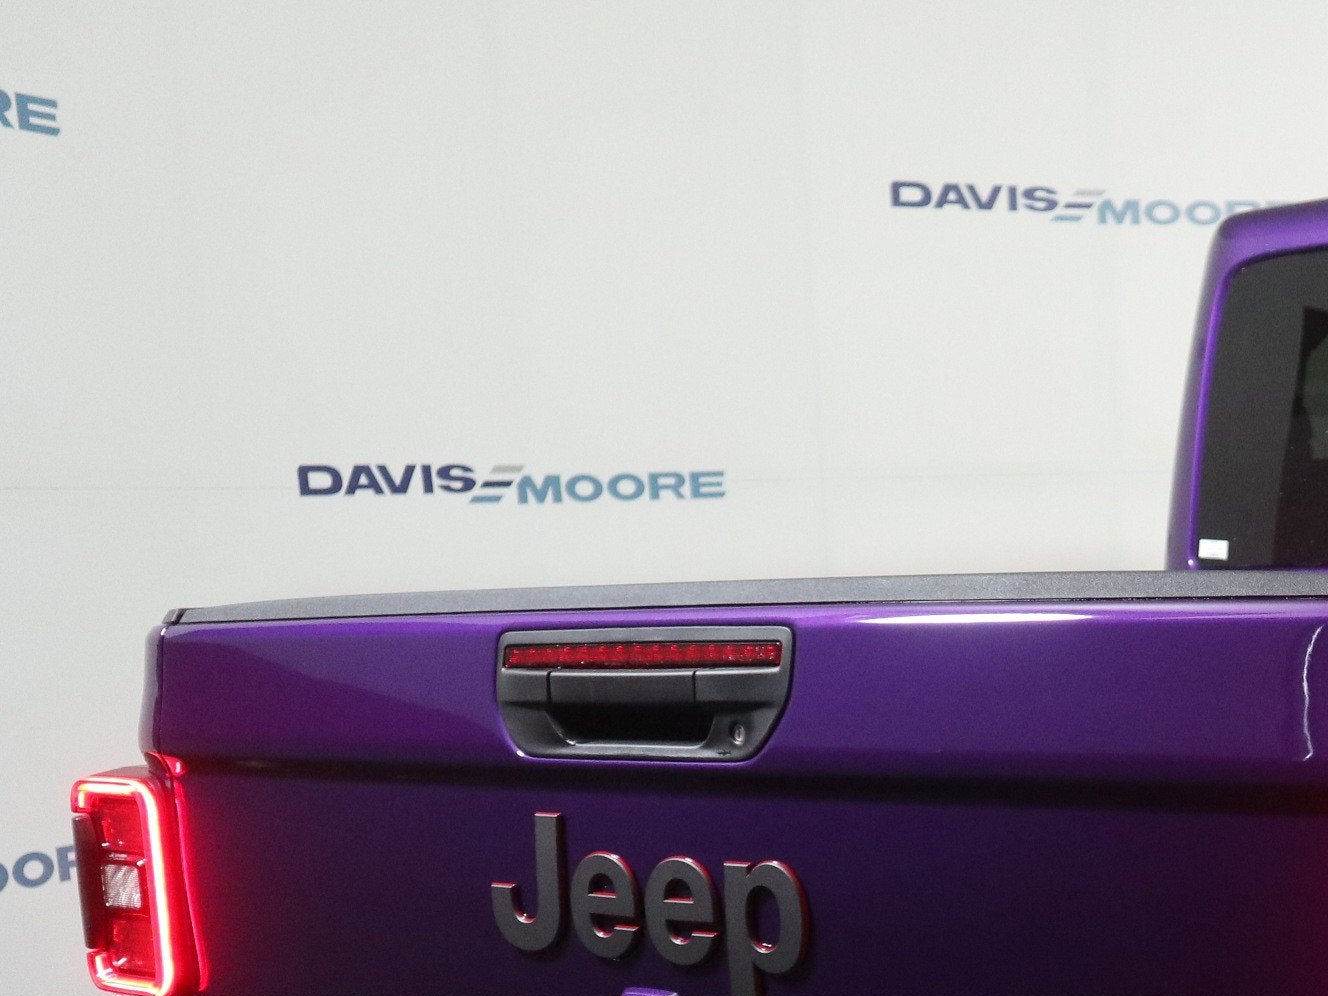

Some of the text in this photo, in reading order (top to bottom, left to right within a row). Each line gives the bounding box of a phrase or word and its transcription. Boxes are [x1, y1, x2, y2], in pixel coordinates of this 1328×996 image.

[889, 180, 1280, 226] DAVIS MOO
[296, 464, 726, 504] DAVIS MOORE
